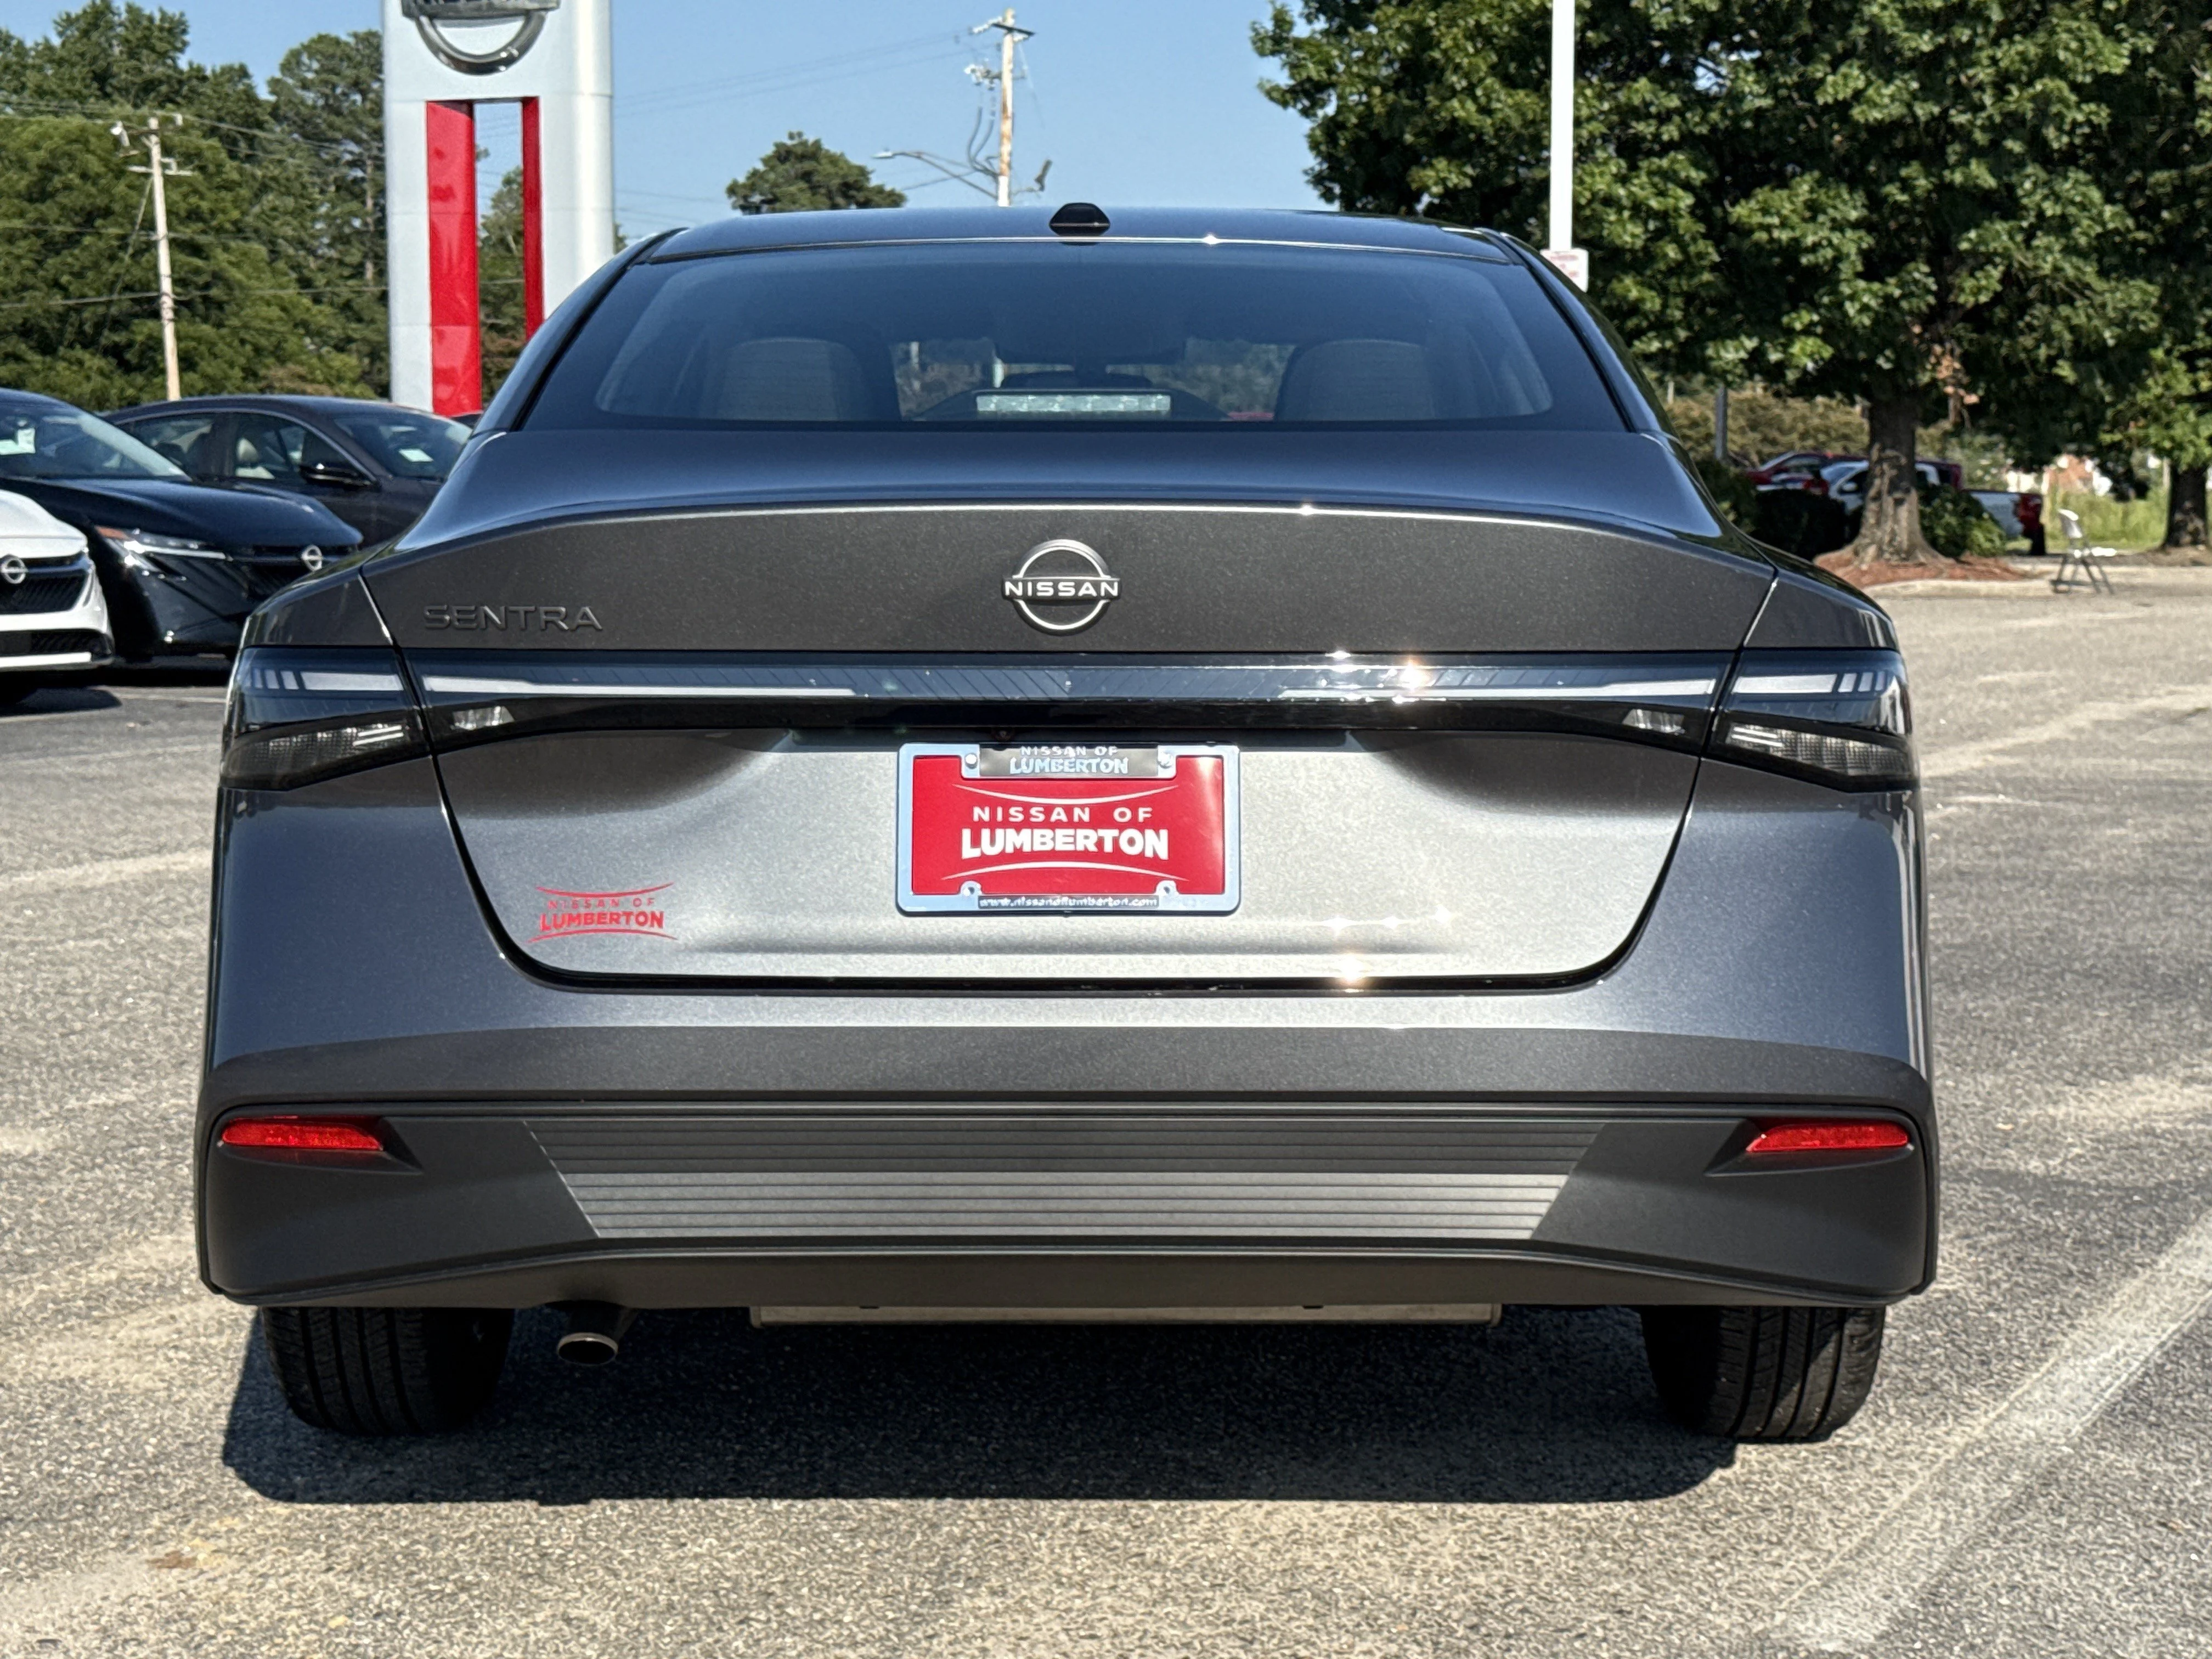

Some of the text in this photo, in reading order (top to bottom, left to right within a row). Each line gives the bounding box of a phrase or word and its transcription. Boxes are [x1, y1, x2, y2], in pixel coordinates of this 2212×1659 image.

[1005, 582, 1118, 596] NISSAN
[424, 604, 603, 631] SENTRA
[1021, 746, 1118, 757] NISSAN OF
[1009, 757, 1128, 774] LUMBERTON
[973, 806, 1153, 822] NISSAN OF
[961, 828, 1169, 860] LUMBERTON
[548, 898, 655, 910] NISSAN OF
[540, 911, 664, 931] LUMBERTON
